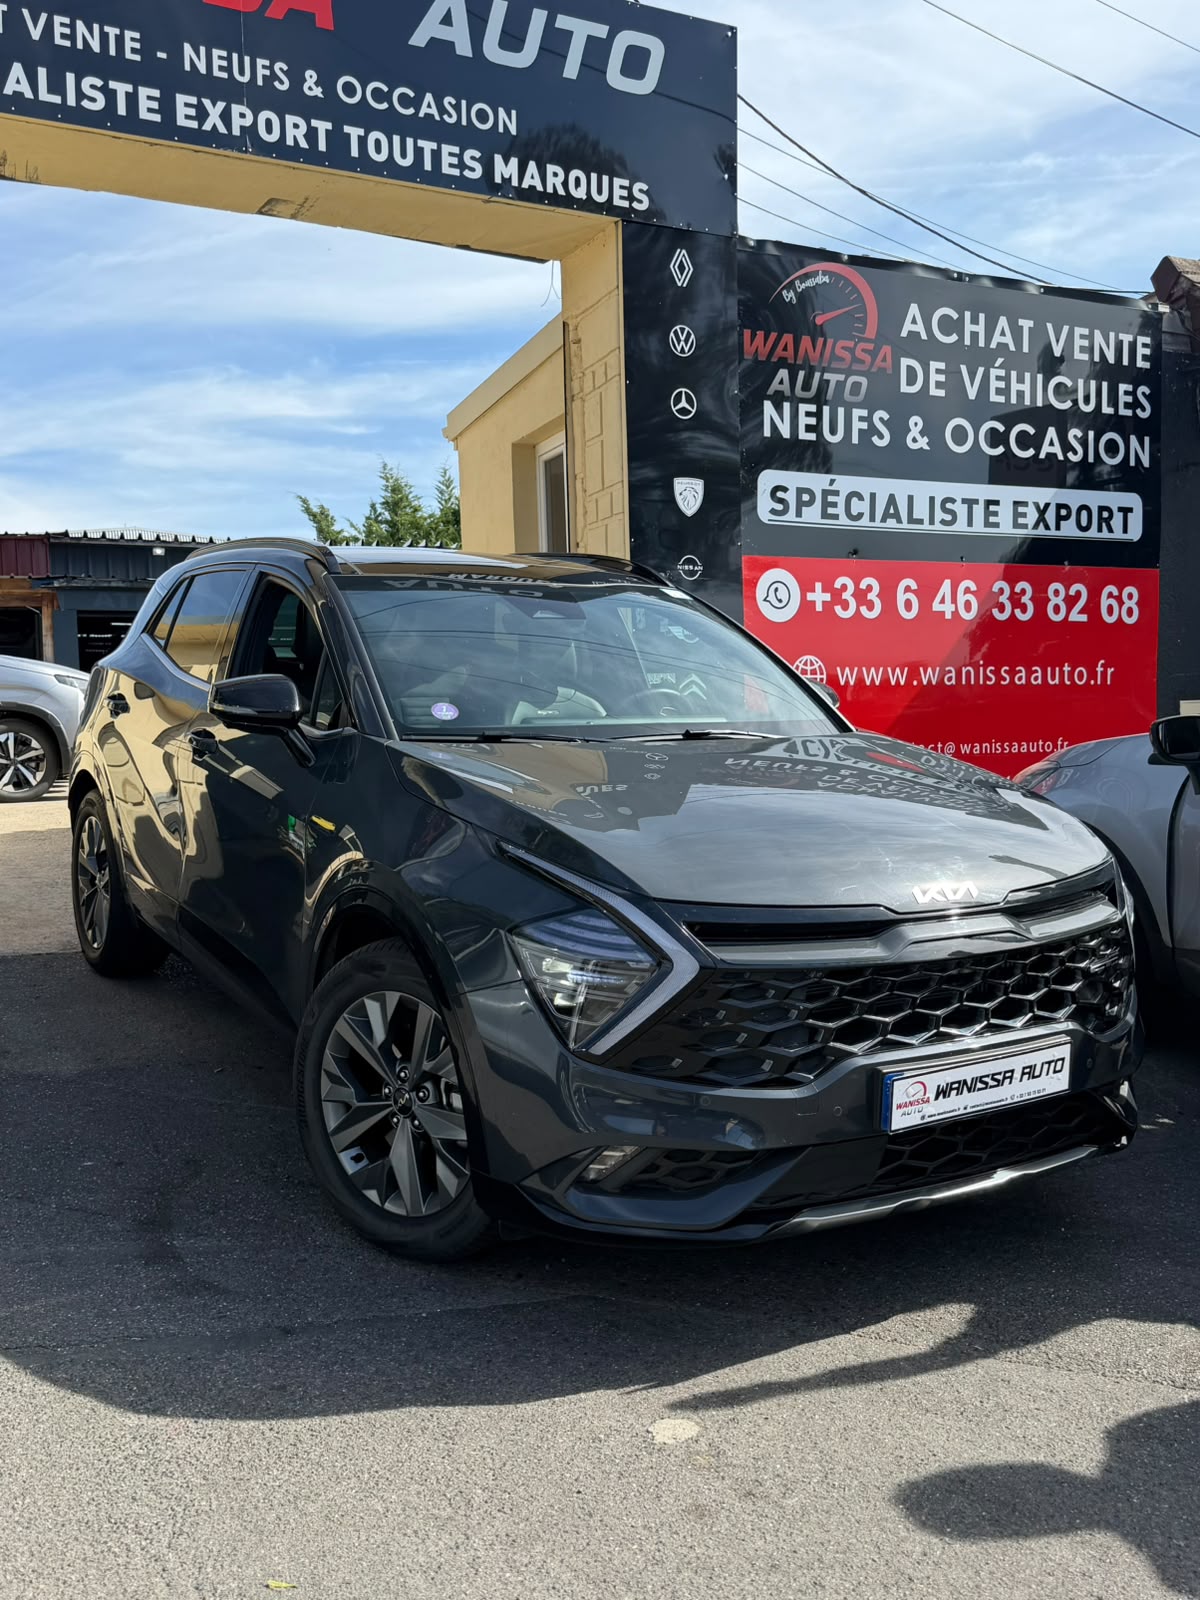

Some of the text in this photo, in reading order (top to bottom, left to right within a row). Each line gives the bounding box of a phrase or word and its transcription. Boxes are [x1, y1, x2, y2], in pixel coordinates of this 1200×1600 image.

[21, 8, 142, 62] VENTE
[183, 42, 290, 91] NEUFS
[302, 69, 325, 99] &
[336, 75, 517, 136] OCCASION
[407, 0, 665, 96] AUTO
[2, 61, 650, 211] ALISTE EXPORT TOUTES MARQUES
[782, 289, 797, 305] By
[743, 329, 893, 374] WANISSA
[899, 303, 1151, 369] ACHAT VENTE
[766, 368, 869, 403] AUTO
[899, 357, 1152, 419] DE VÉHICULES
[763, 399, 1151, 468] NEUFS & OCCASION
[767, 478, 1134, 535] SPÉCIALISTE EXPORT
[806, 576, 1140, 625] +33 6 46 33 82 68
[836, 660, 1115, 686] www.wanissaauto.fr
[895, 1095, 931, 1111] WANISSA
[934, 1069, 1015, 1101] WANISSA
[1019, 1057, 1066, 1083] AUTO
